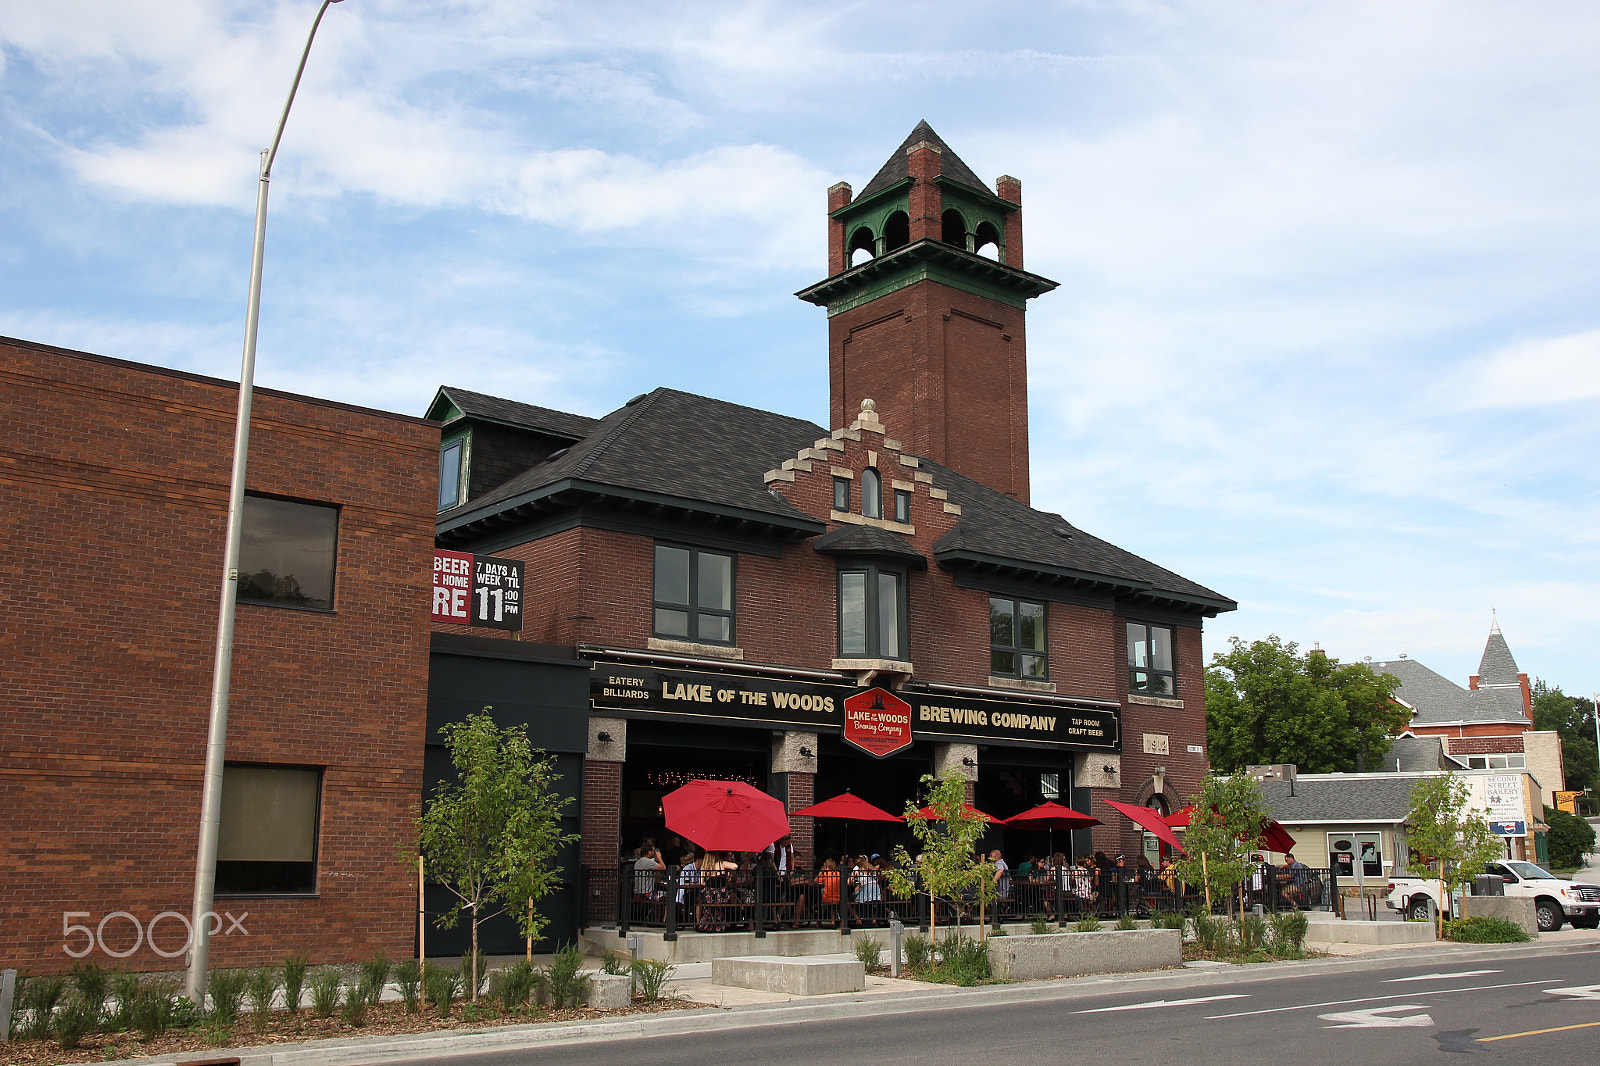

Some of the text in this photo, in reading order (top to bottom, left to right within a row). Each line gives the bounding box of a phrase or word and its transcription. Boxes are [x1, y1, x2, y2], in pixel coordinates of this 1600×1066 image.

[433, 556, 470, 576] BEER
[476, 561, 518, 578] 7 DAYS A
[442, 574, 469, 588] HOME
[476, 573, 501, 586] WEEK
[432, 586, 468, 618] RE
[504, 605, 518, 614] PM
[608, 676, 645, 687] EATERY
[603, 687, 650, 700] BILLIARDS
[662, 681, 835, 713] LAKE OF THE WOODS
[848, 710, 871, 721] LAKE
[878, 713, 908, 724] WOODS
[919, 705, 1057, 732] BREWING COMPANY
[853, 720, 903, 736] Brewing Company
[1071, 718, 1100, 727] TAP ROOM
[1068, 727, 1104, 737] CRAFT BEER
